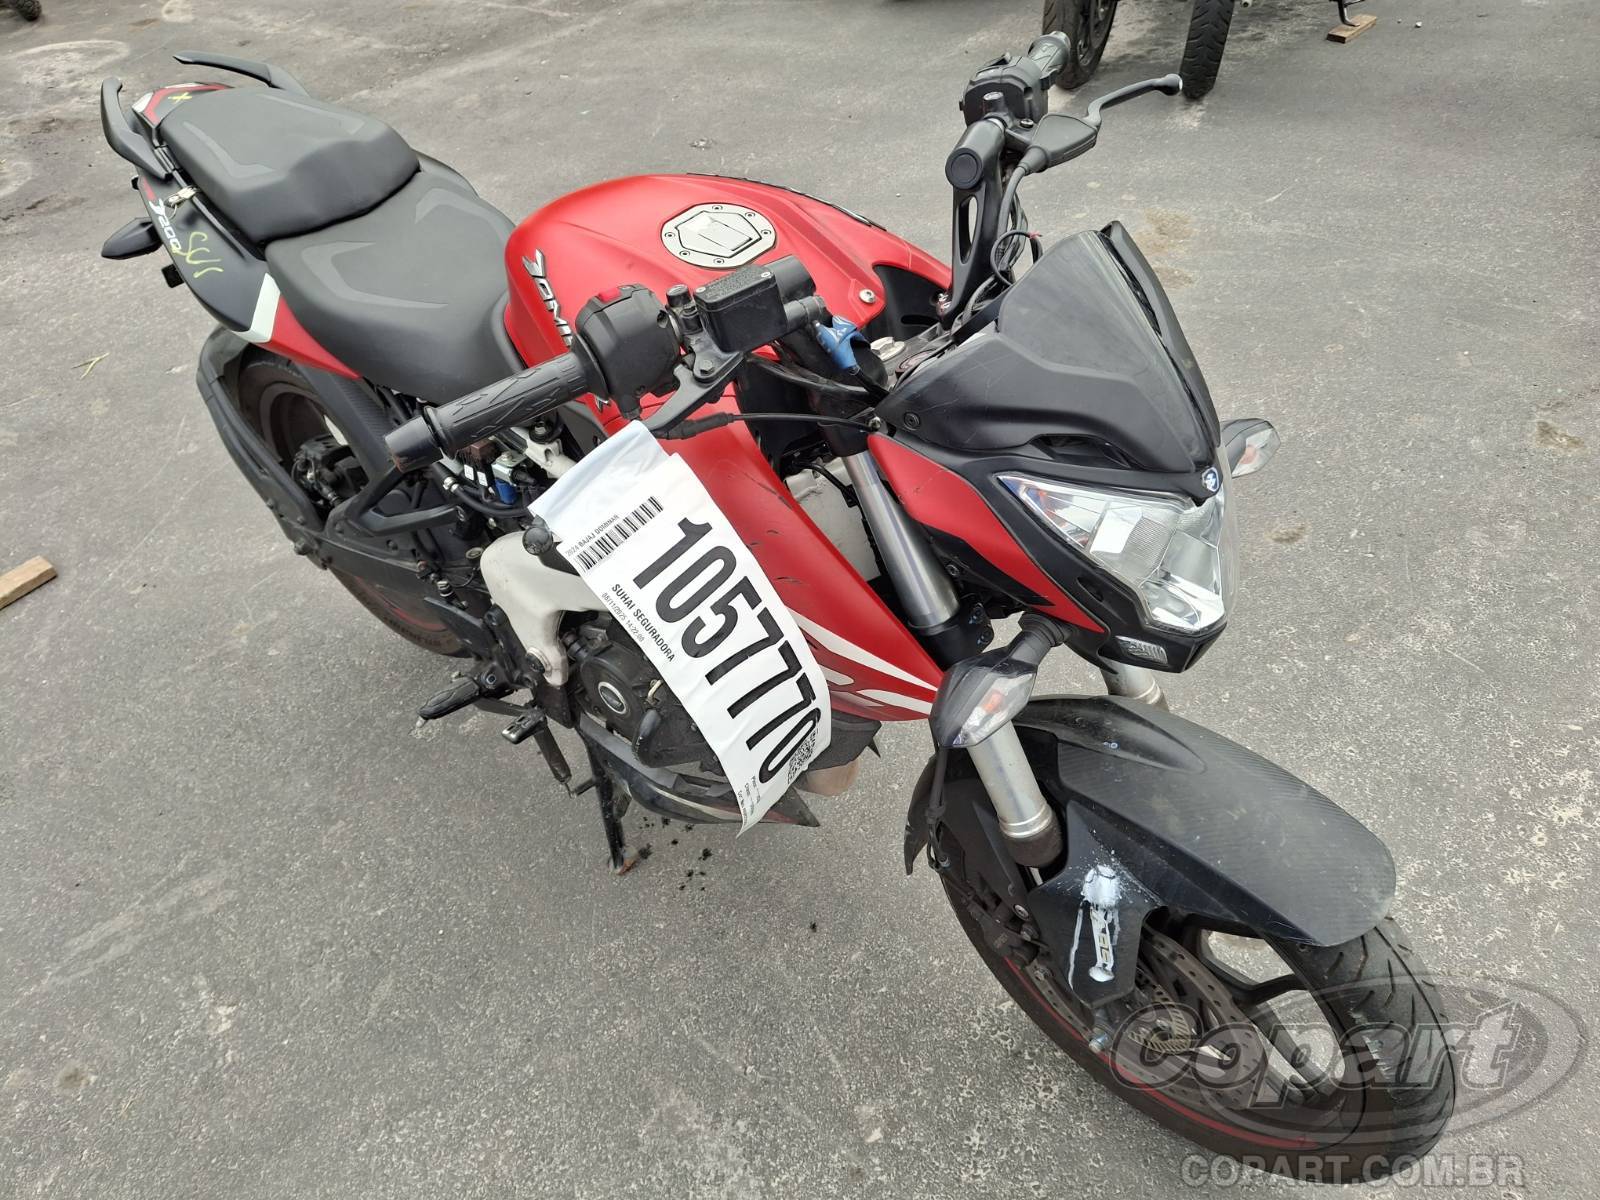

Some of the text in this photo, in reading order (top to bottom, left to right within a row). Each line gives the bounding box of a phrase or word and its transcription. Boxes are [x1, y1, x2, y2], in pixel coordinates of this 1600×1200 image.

[521, 248, 574, 348] DOMI
[565, 544, 580, 557] 2024
[578, 533, 596, 549] BAJAJ
[611, 583, 676, 662] SUHAI SEGURADORA
[632, 517, 821, 784] 1057770
